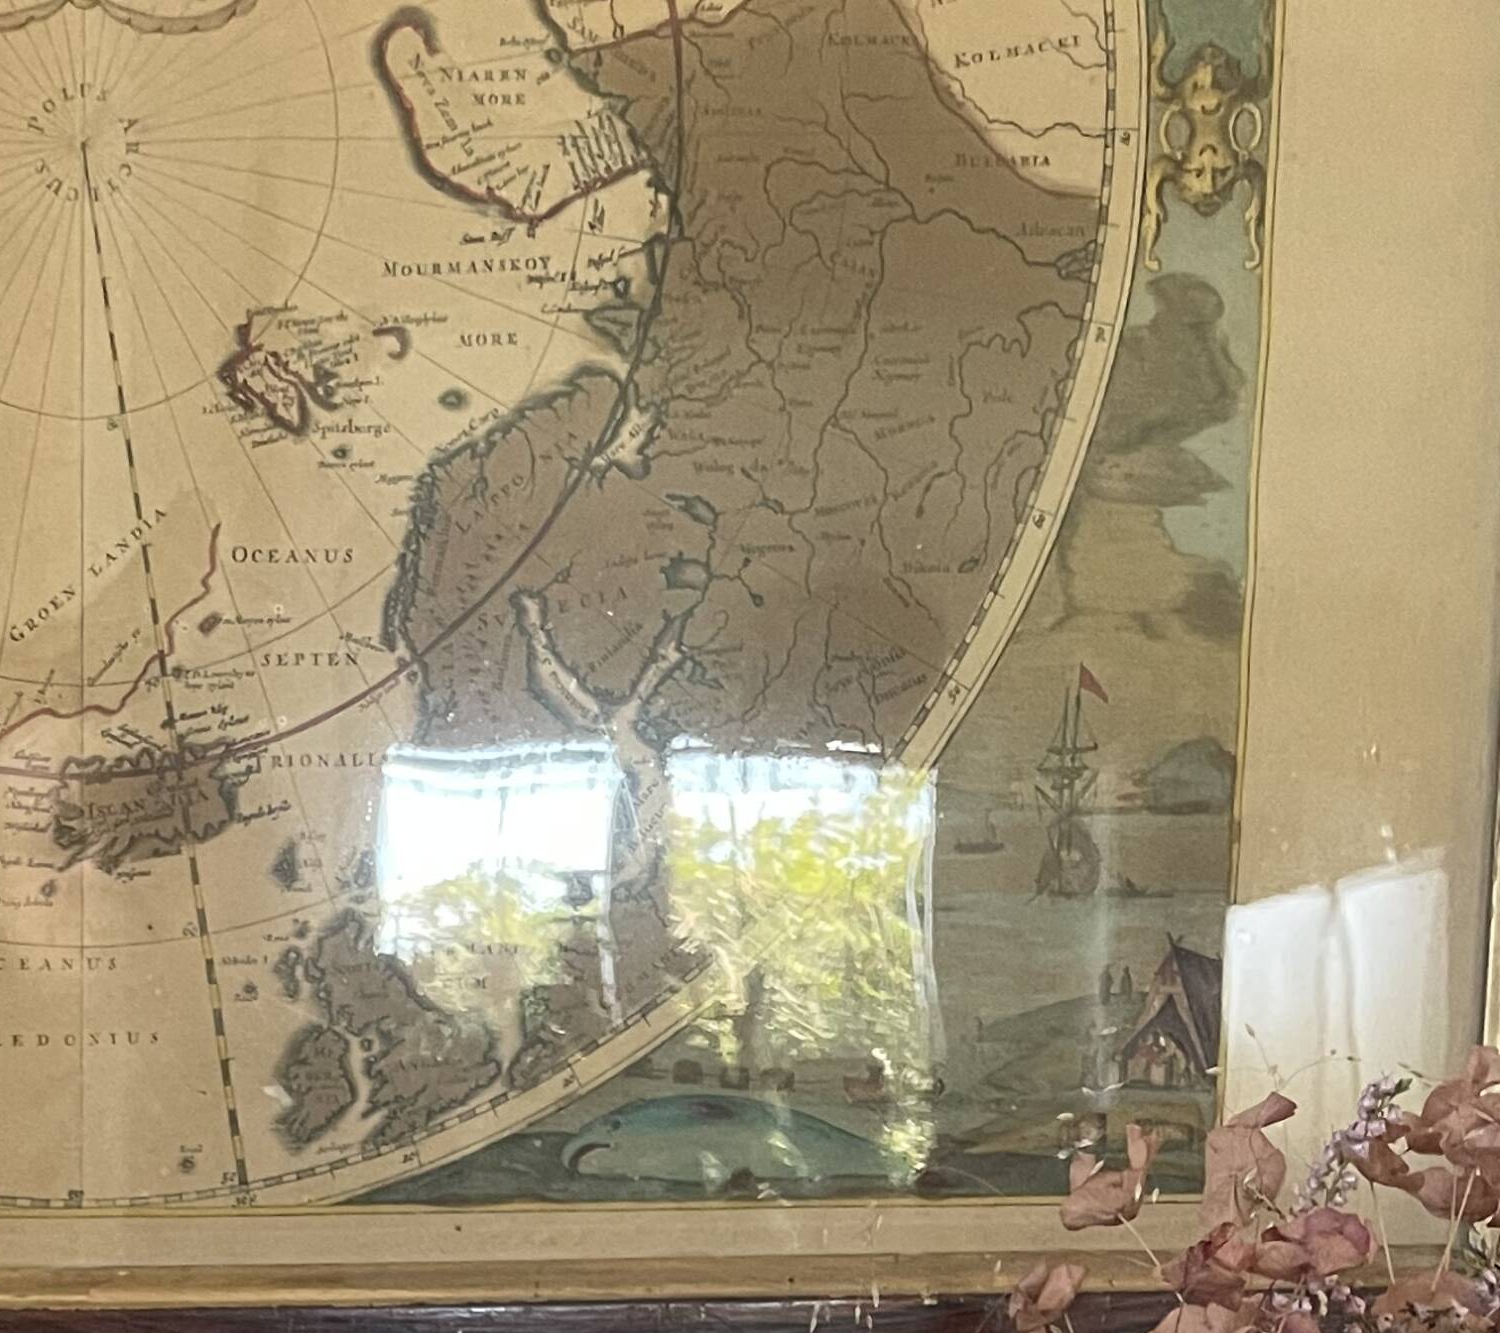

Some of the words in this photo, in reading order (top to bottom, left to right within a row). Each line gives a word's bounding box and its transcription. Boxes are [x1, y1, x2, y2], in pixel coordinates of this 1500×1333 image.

[26, 82, 109, 135] POLUS
[34, 116, 141, 203] ARCTICUS
[382, 255, 551, 279] MOURMANSKOY
[459, 332, 518, 348] MORE
[230, 545, 355, 565] OCEANUS
[260, 651, 359, 667] SEPTEN
